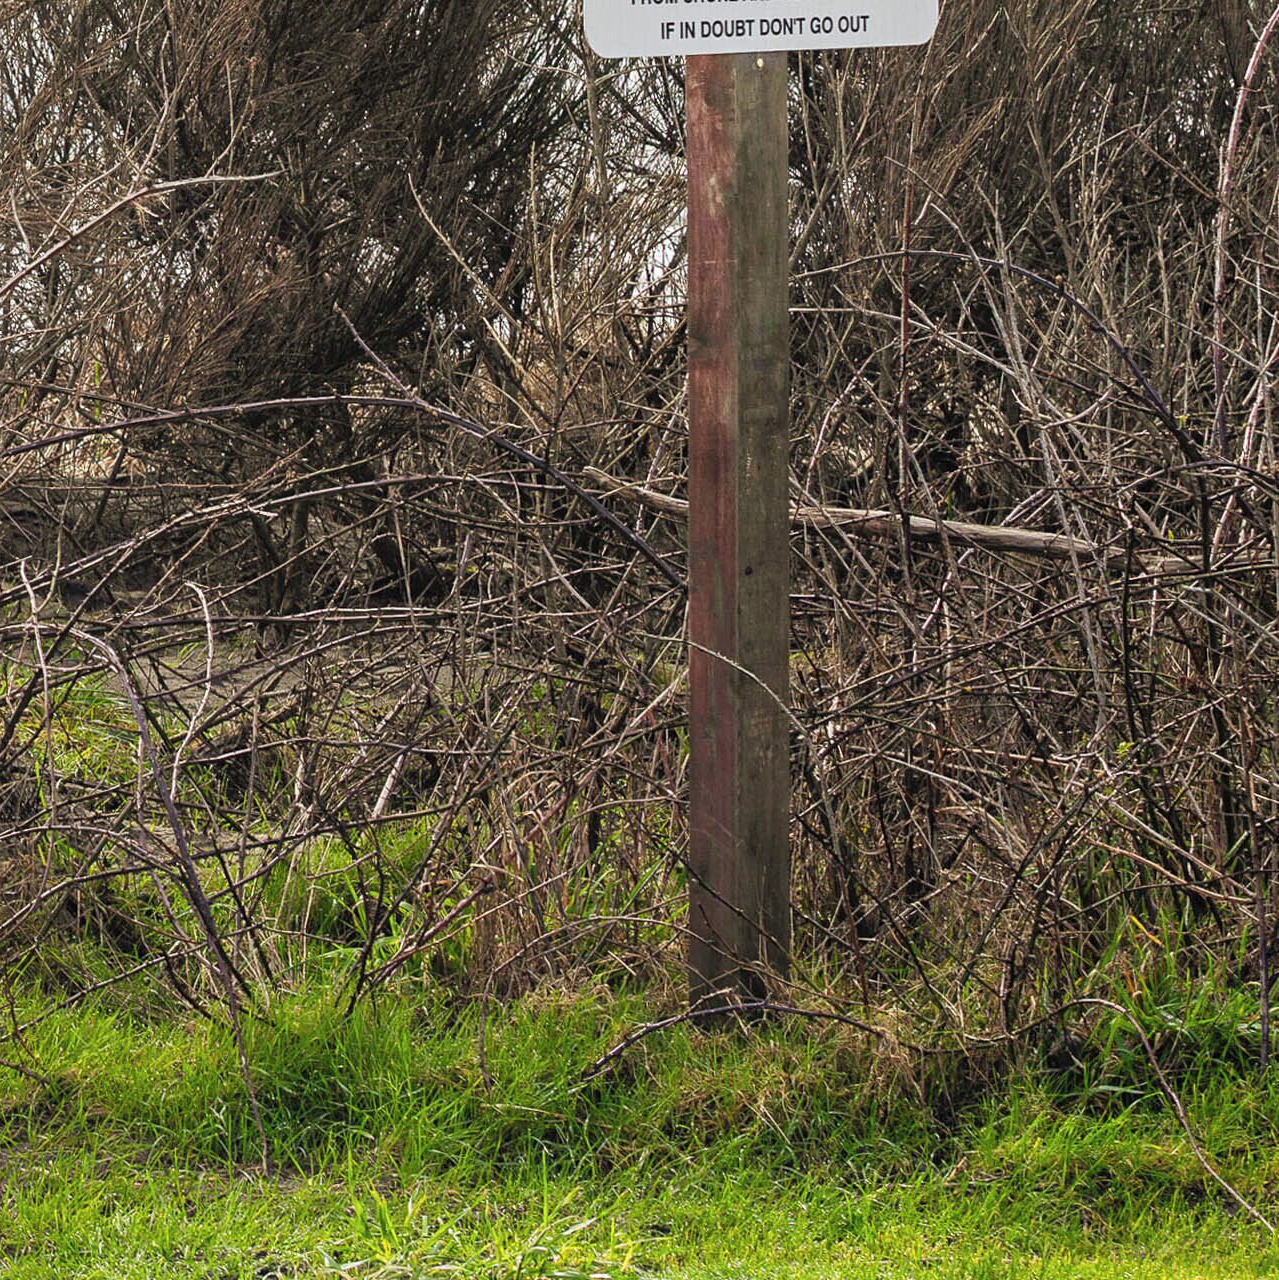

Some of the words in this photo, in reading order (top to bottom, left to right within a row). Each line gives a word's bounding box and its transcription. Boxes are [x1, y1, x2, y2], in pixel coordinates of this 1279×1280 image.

[660, 21, 676, 40] IF
[679, 21, 696, 40] IN
[700, 19, 756, 39] DOUBT
[759, 17, 806, 37] DON'T
[809, 16, 834, 35] GO
[837, 15, 870, 34] OUT
